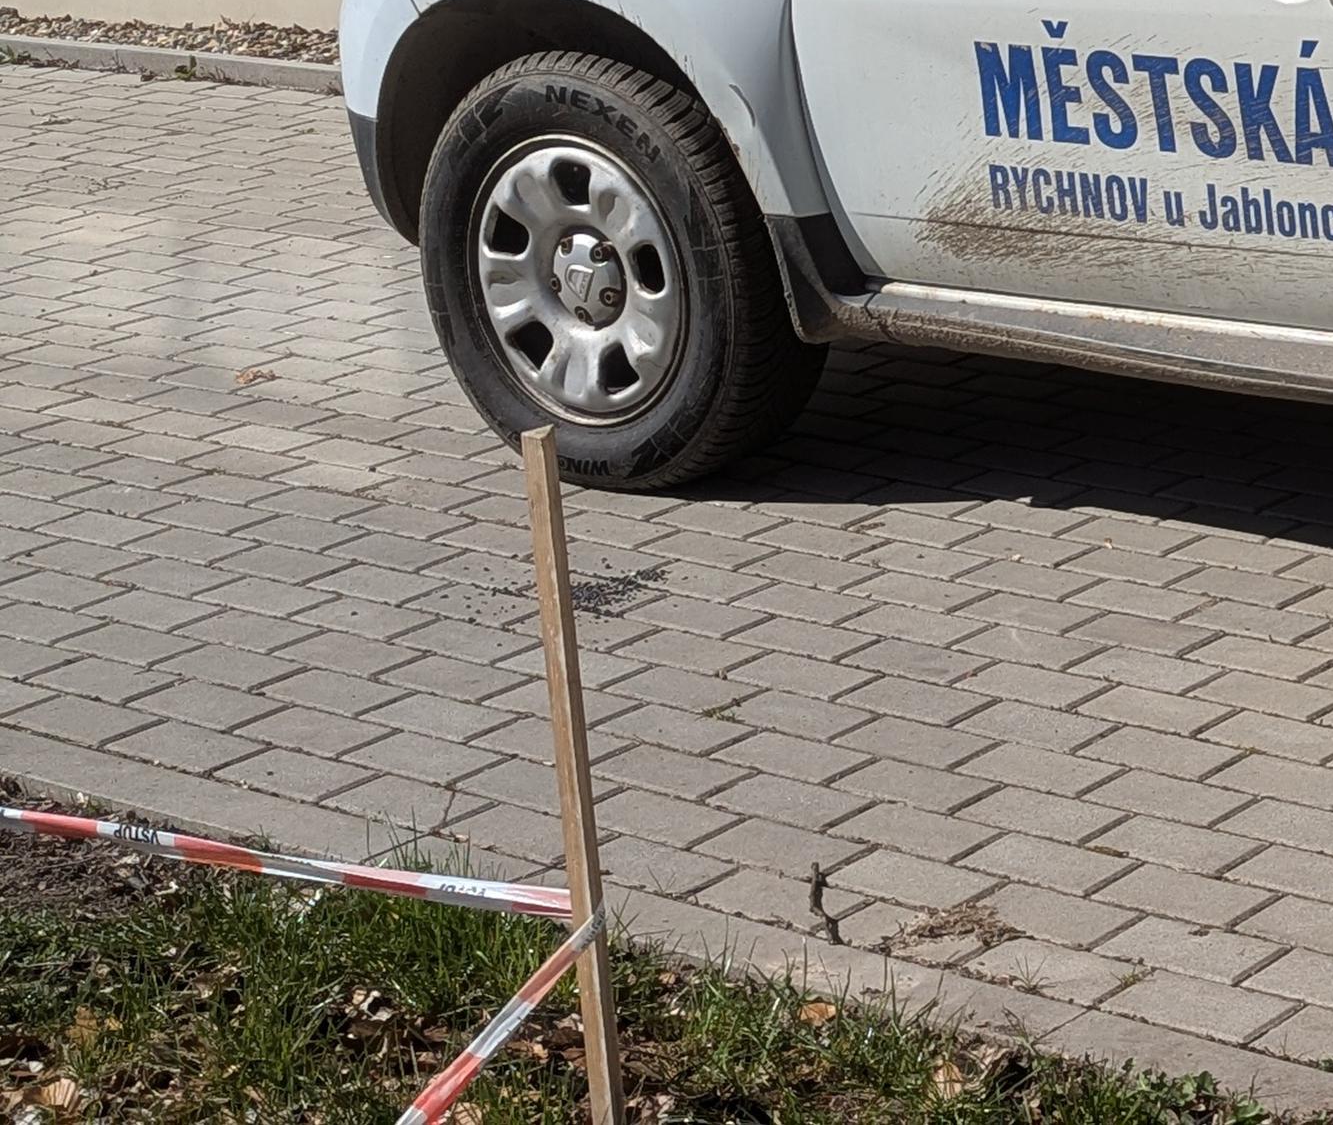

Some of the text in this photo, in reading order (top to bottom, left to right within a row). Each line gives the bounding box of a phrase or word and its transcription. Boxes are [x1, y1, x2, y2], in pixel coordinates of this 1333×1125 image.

[545, 84, 660, 163] NEXEN
[989, 164, 1149, 224] RYCHNOV
[1163, 192, 1183, 228] u
[114, 822, 160, 844] VSTUP
